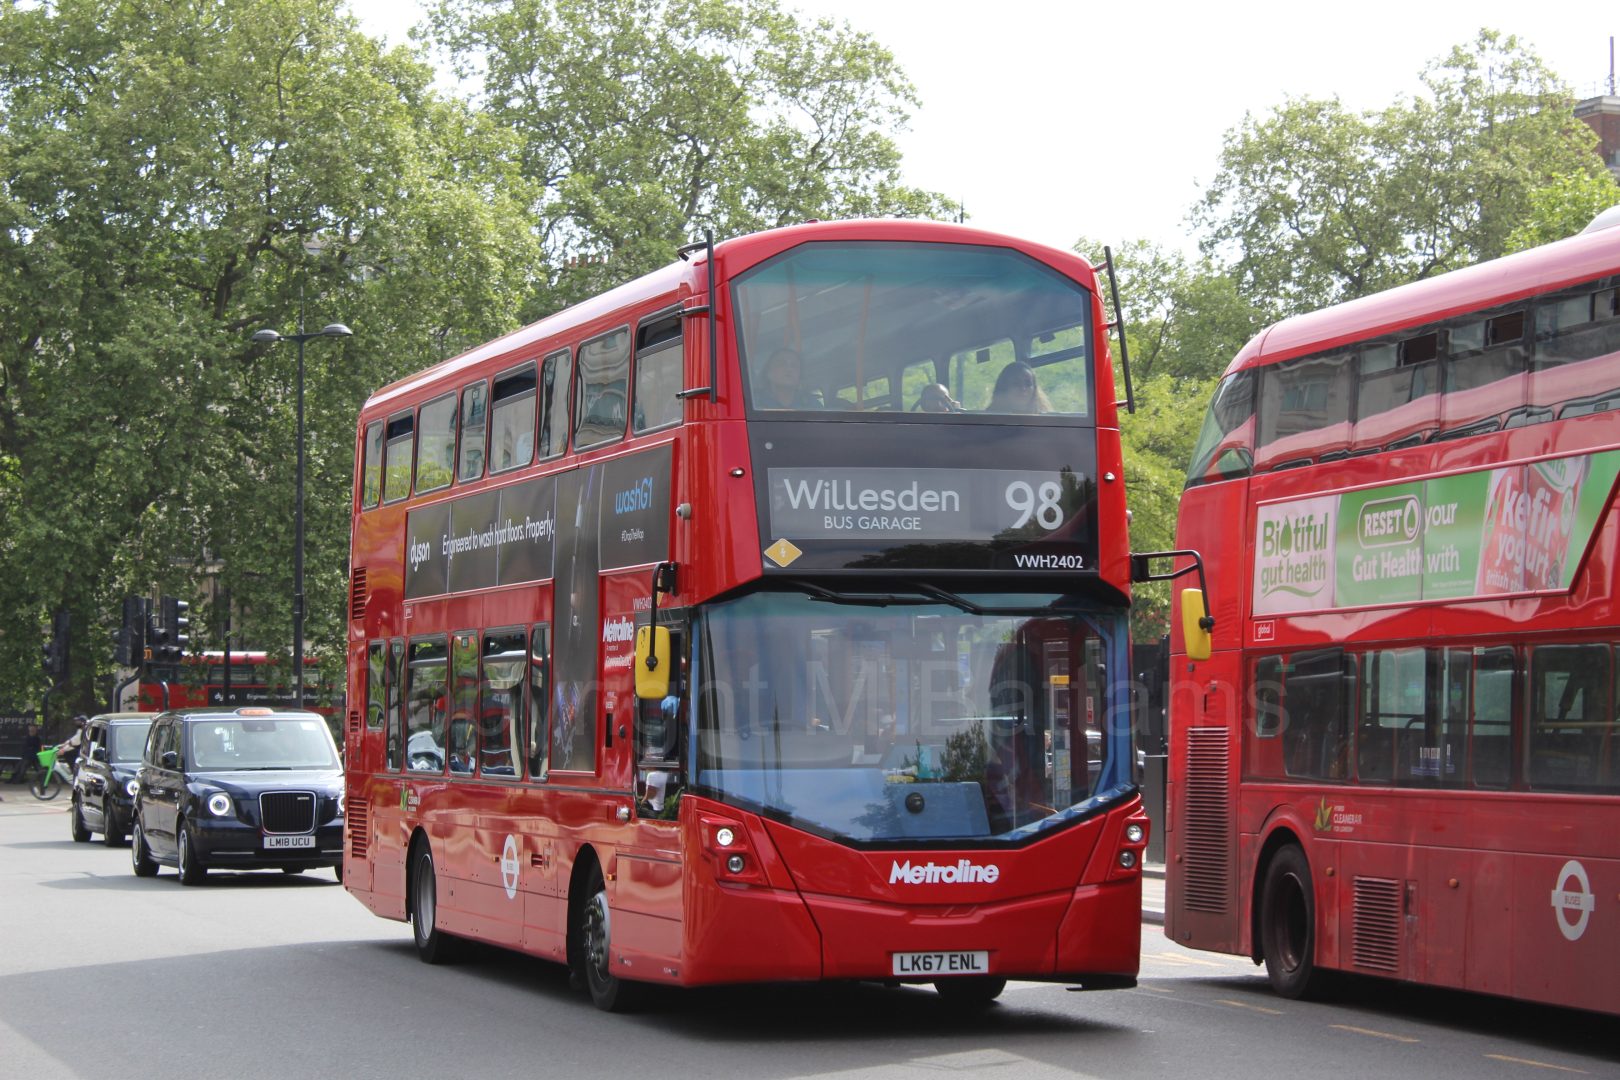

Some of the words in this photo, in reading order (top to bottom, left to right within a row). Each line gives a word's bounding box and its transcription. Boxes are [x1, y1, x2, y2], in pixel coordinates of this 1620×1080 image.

[615, 476, 653, 515] washG1
[783, 478, 960, 512] Willesden
[1004, 480, 1064, 530] 98
[824, 516, 853, 530] BUS
[858, 516, 922, 531] GARAGE
[1364, 508, 1403, 537] RESET
[1423, 502, 1458, 534] your
[1502, 476, 1556, 550] kefir
[442, 528, 473, 559] Engineered
[472, 530, 479, 549] to
[479, 522, 495, 548] wash
[495, 519, 508, 546] hard
[508, 518, 525, 542] floors.
[525, 510, 555, 543] Properly.
[410, 536, 431, 572] dyson
[1014, 554, 1084, 569] VWH2402
[1352, 554, 1378, 582] Gut
[1380, 547, 1424, 578] Health
[1427, 543, 1460, 574] with
[1495, 532, 1549, 586] yogurt
[1261, 559, 1284, 594] gut
[1286, 554, 1327, 583] health
[603, 615, 634, 643] Metroline
[269, 837, 290, 847] LM18
[291, 837, 310, 847] UCU
[888, 859, 1000, 884] Metroline
[900, 954, 944, 972] LK67
[949, 953, 981, 970] ENL
